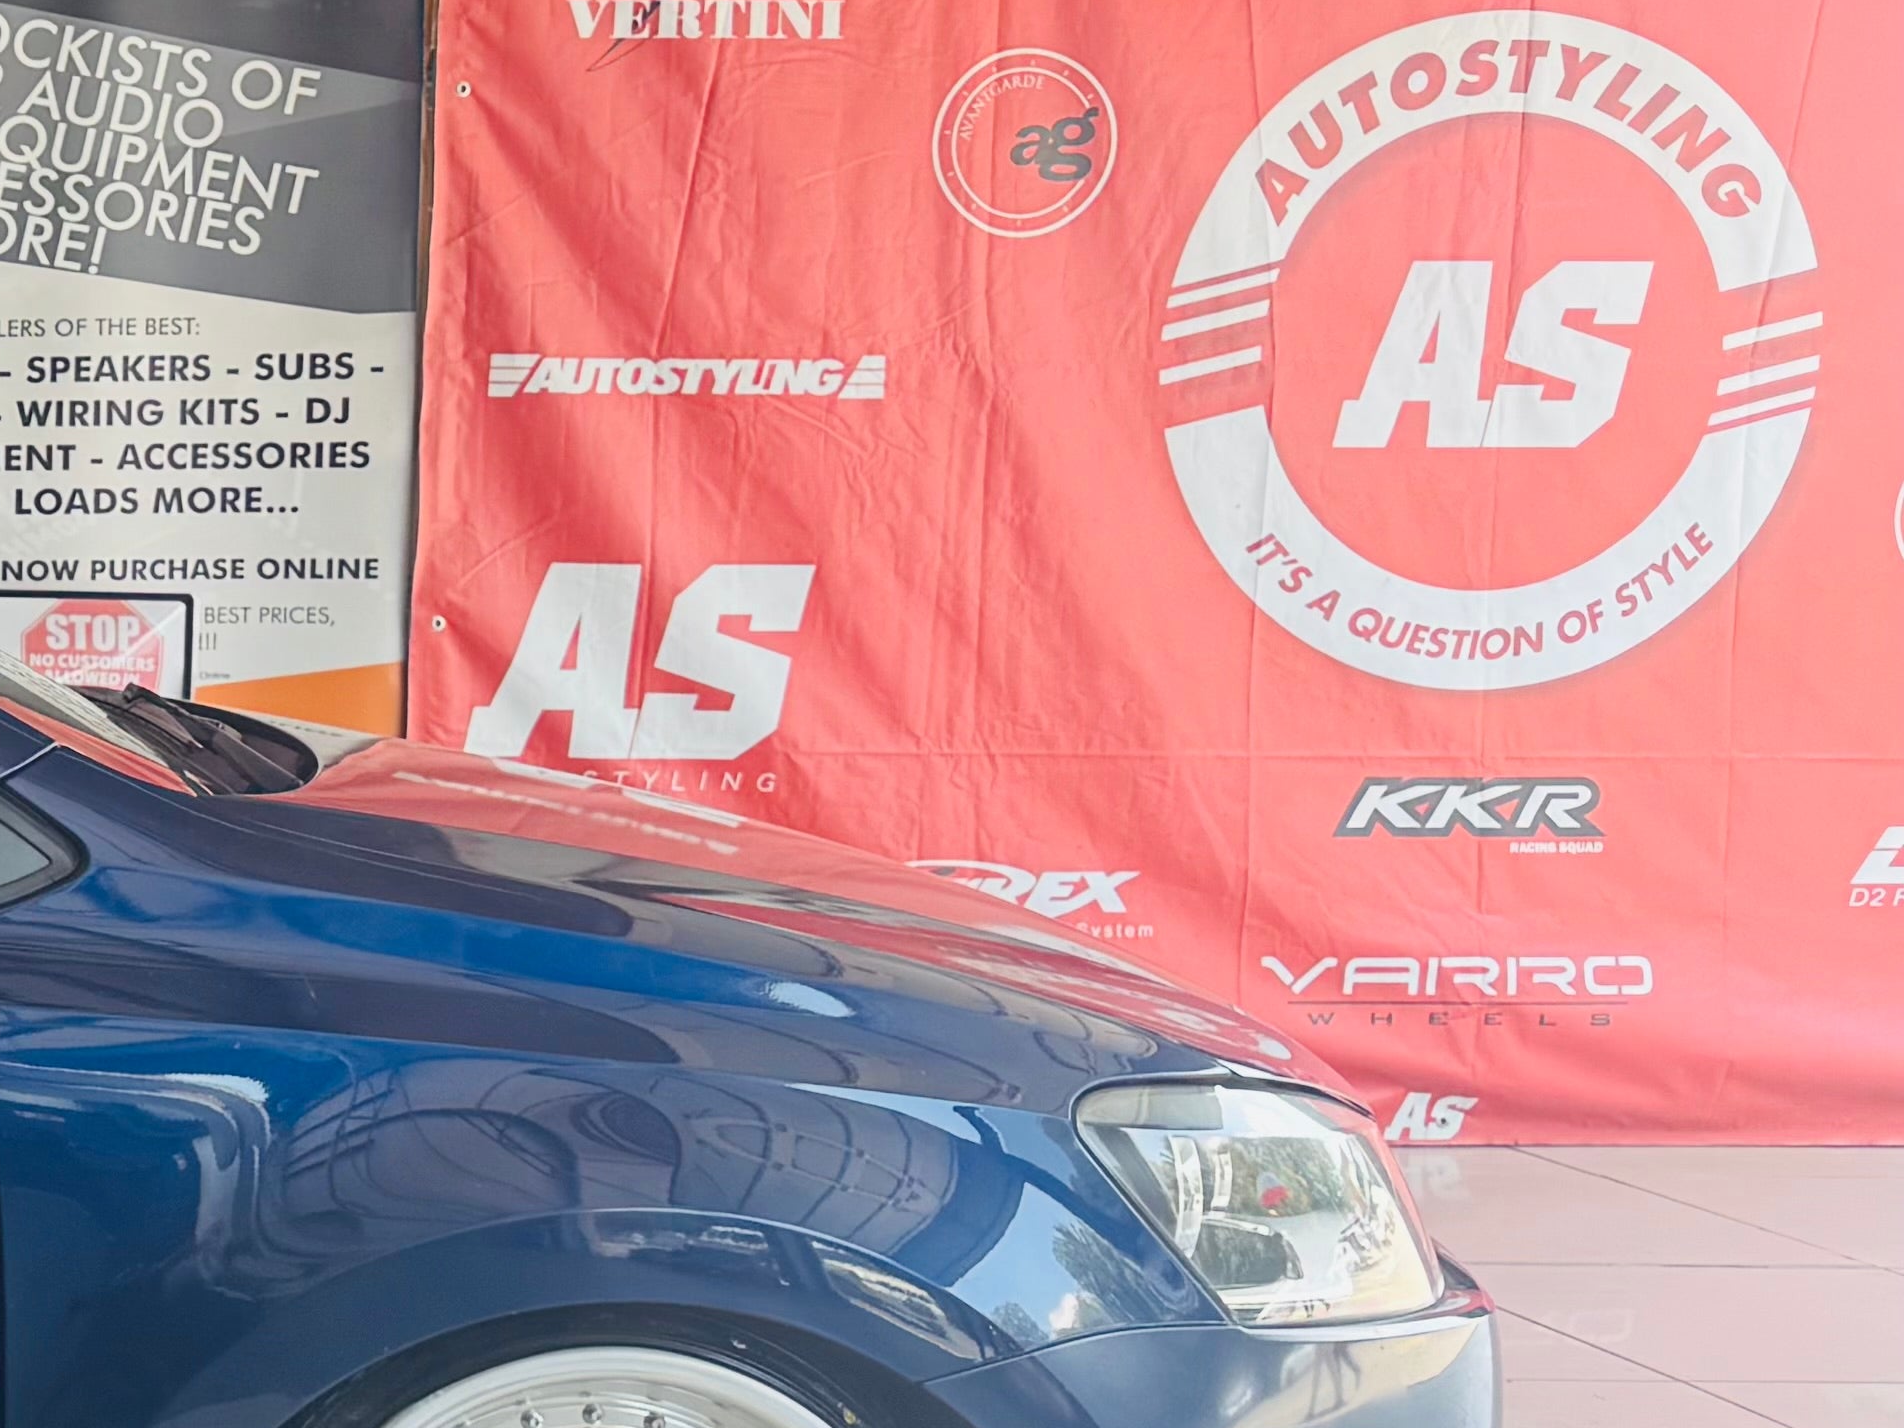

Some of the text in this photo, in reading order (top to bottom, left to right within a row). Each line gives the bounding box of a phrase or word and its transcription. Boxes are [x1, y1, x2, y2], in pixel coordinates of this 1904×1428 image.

[230, 59, 323, 116] OF
[960, 74, 1045, 141] AVANTGARDE
[17, 77, 225, 149] AUDIO
[1253, 37, 1764, 229] AUTOSTYLING
[1010, 106, 1100, 181] ag
[54, 318, 87, 338] OF
[95, 317, 137, 337] THE
[144, 317, 200, 337] BEST:
[25, 355, 212, 384] SPEAKERS
[253, 351, 355, 381] SUBS
[525, 354, 847, 397] AUTOSTYLING
[1331, 260, 1655, 449] AS
[16, 398, 164, 428] WIRING
[178, 397, 261, 426] KITS
[305, 397, 351, 425] DJ
[116, 441, 371, 470] ACCESSORIES
[13, 488, 140, 515] LOADS
[152, 485, 300, 515] MORE...
[0, 559, 79, 582] NOW
[91, 558, 246, 582] PURCHASE
[256, 557, 380, 581] ONLINE
[1244, 520, 1716, 662] IT'S QUESTION STYLE
[46, 614, 141, 651] STOP
[203, 605, 336, 628] BEST PRICES,
[29, 653, 156, 669] NO CUSTOMERS
[463, 561, 818, 761] AS
[1341, 782, 1599, 832] KKR
[1306, 1011, 1613, 1027] WHEELS
[1383, 1091, 1480, 1141] AS
